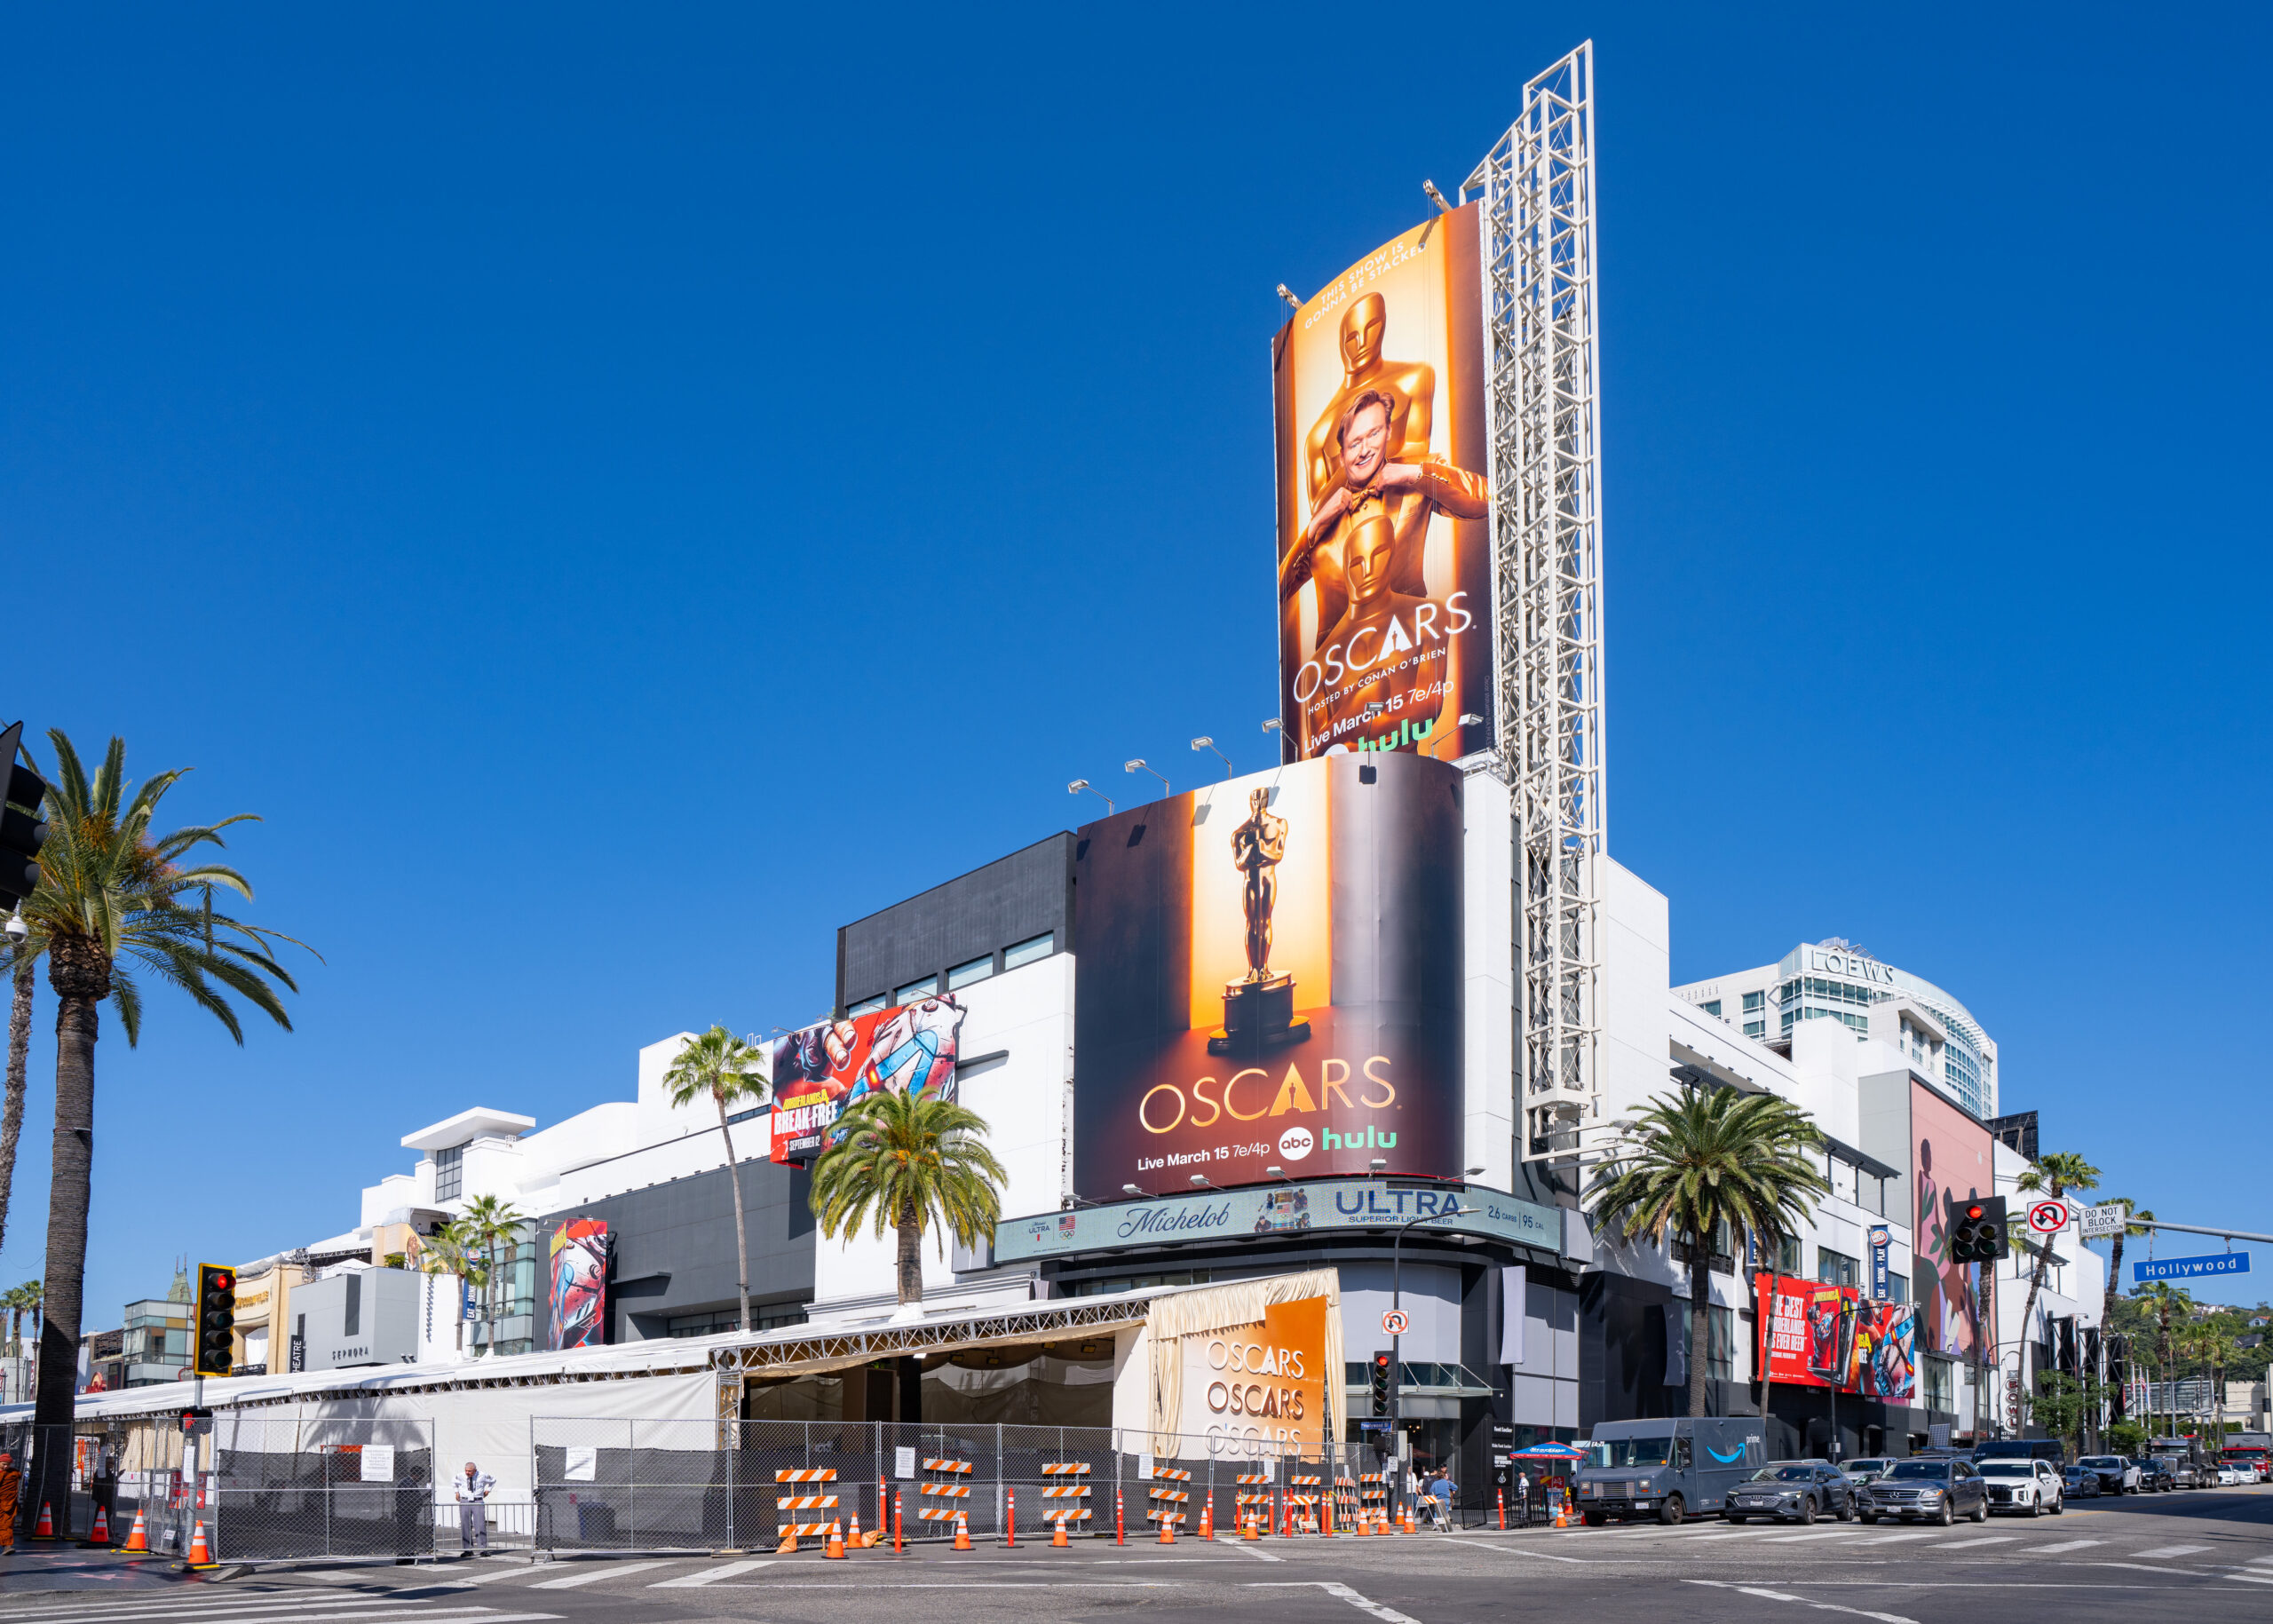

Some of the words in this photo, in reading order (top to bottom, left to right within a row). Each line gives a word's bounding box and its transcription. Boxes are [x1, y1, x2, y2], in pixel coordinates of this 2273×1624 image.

[1305, 291, 1347, 329] GONNA
[1351, 277, 1364, 293] BE
[1369, 242, 1426, 281] STACKED
[1321, 281, 1344, 305] THIS
[1349, 250, 1387, 283] SHOW
[1392, 242, 1404, 255] IS
[1293, 591, 1472, 703] OSCARS
[1308, 691, 1341, 716] HOSTED
[1343, 683, 1355, 695] BY
[1358, 666, 1396, 688] CONAN
[1304, 730, 1330, 753] Live
[1385, 694, 1403, 713] 15
[1407, 680, 1454, 704] 7e/4p
[1358, 717, 1433, 752] hulu
[1811, 949, 1896, 986] LOEWS
[1139, 1055, 1396, 1134] OSCARS
[773, 1106, 811, 1135] BREAK
[812, 1100, 838, 1128] FREE
[789, 1136, 815, 1152] SEPTEMBER
[815, 1135, 820, 1146] 12
[1280, 1135, 1311, 1150] abc
[1322, 1125, 1398, 1151] hulu
[1137, 1154, 1164, 1171] Live
[1167, 1149, 1210, 1167] March
[1214, 1146, 1229, 1160] 15
[1232, 1142, 1271, 1159] 7e/4p
[1335, 1190, 1461, 1216] ULTRA
[2085, 1209, 2096, 1218] DO
[2101, 1207, 2118, 1216] NOT
[1117, 1202, 1231, 1238] Michelob
[1431, 1216, 1453, 1225] BEER
[1488, 1205, 1501, 1220] 2.6
[1501, 1213, 1517, 1223] CARBS
[1523, 1215, 1533, 1228] 95
[2082, 1224, 2123, 1233] INTERSECTION
[2088, 1216, 2116, 1227] BLOCK
[2145, 1257, 2237, 1276] Hollywood
[1877, 1288, 1886, 1298] EAT
[1785, 1295, 1804, 1319] BEST
[1765, 1315, 1805, 1335] RDERLANDS
[332, 1346, 368, 1361] SEPHORA
[1776, 1333, 1790, 1350] EVER
[1207, 1339, 1304, 1379] OSCARS
[1208, 1381, 1303, 1420] OSCARS
[1204, 1422, 1302, 1456] OSCARS
[1746, 1432, 1760, 1446] prime
